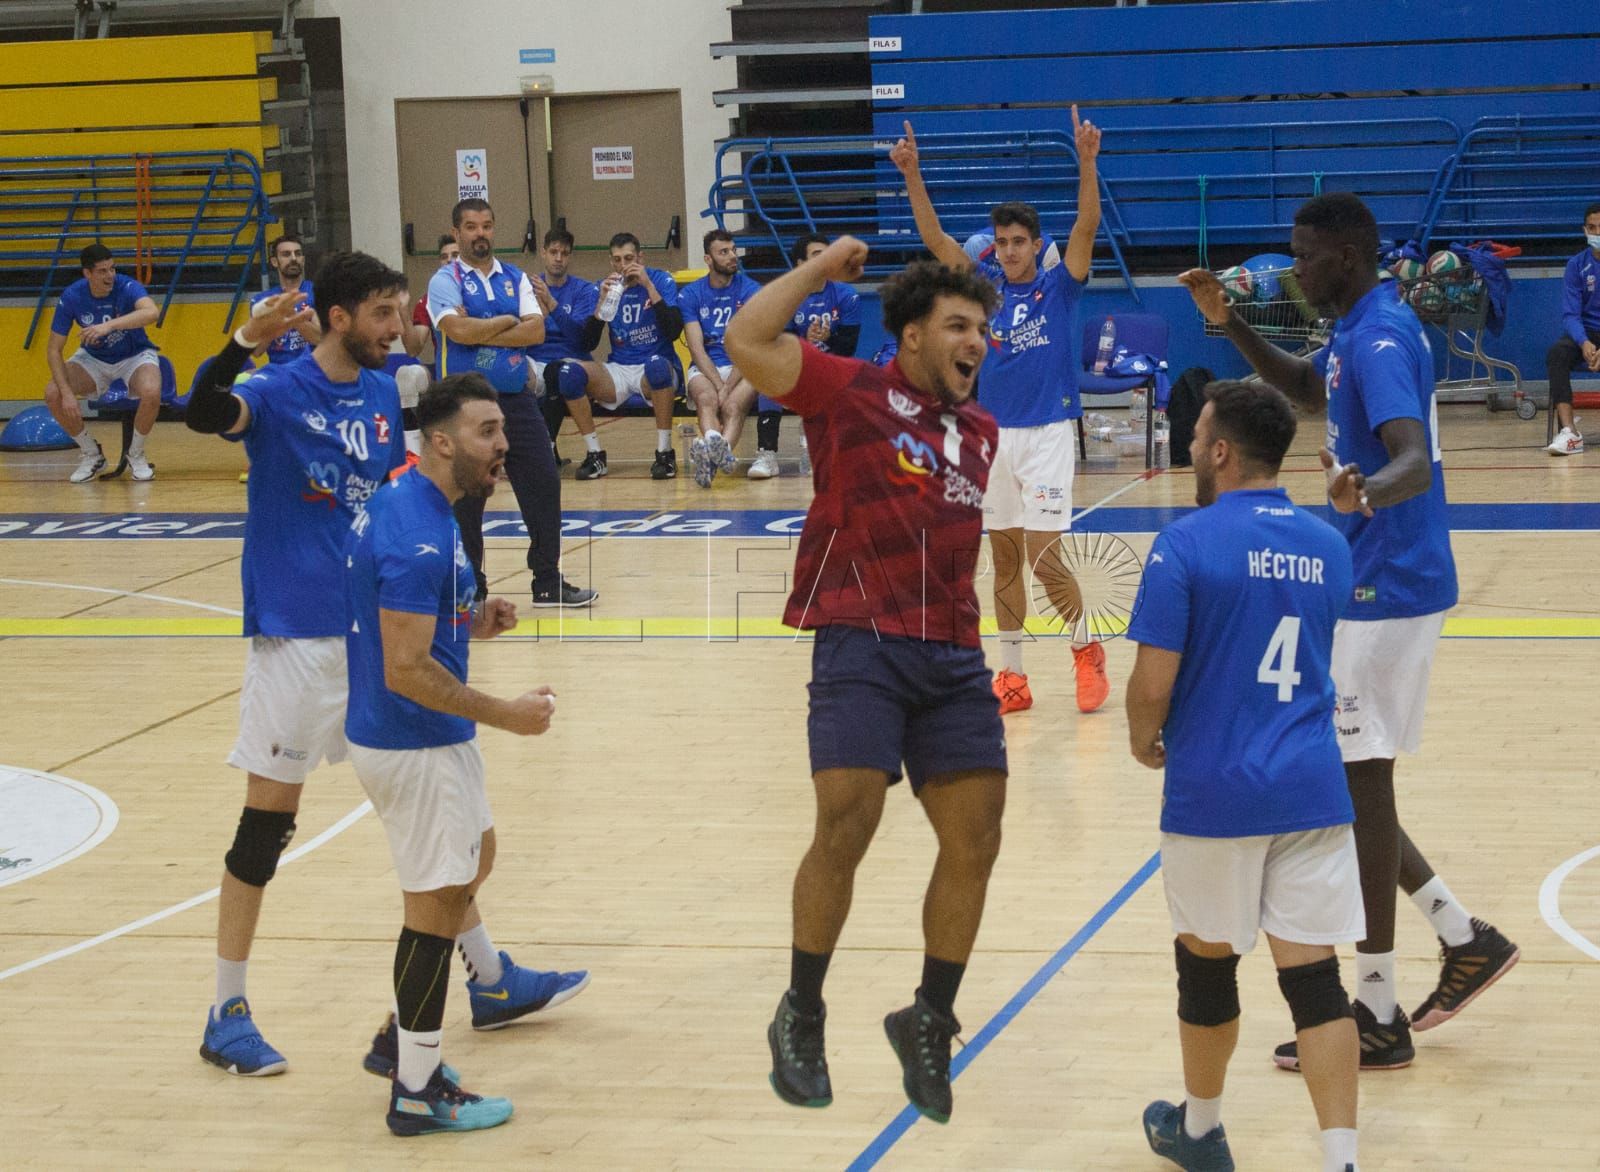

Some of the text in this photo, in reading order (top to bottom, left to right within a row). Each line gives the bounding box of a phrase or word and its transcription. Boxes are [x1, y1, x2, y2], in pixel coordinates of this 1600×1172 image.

[873, 40, 890, 48] FILA
[622, 303, 641, 324] 87
[1012, 303, 1029, 327] 6
[1009, 314, 1047, 339] MELILLA
[1010, 326, 1042, 346] SPORT
[1011, 335, 1051, 354] CAPITAL
[335, 419, 369, 461] 10
[940, 413, 963, 467] 1
[1248, 547, 1324, 585] HÉCTOR
[1257, 615, 1301, 702] 4
